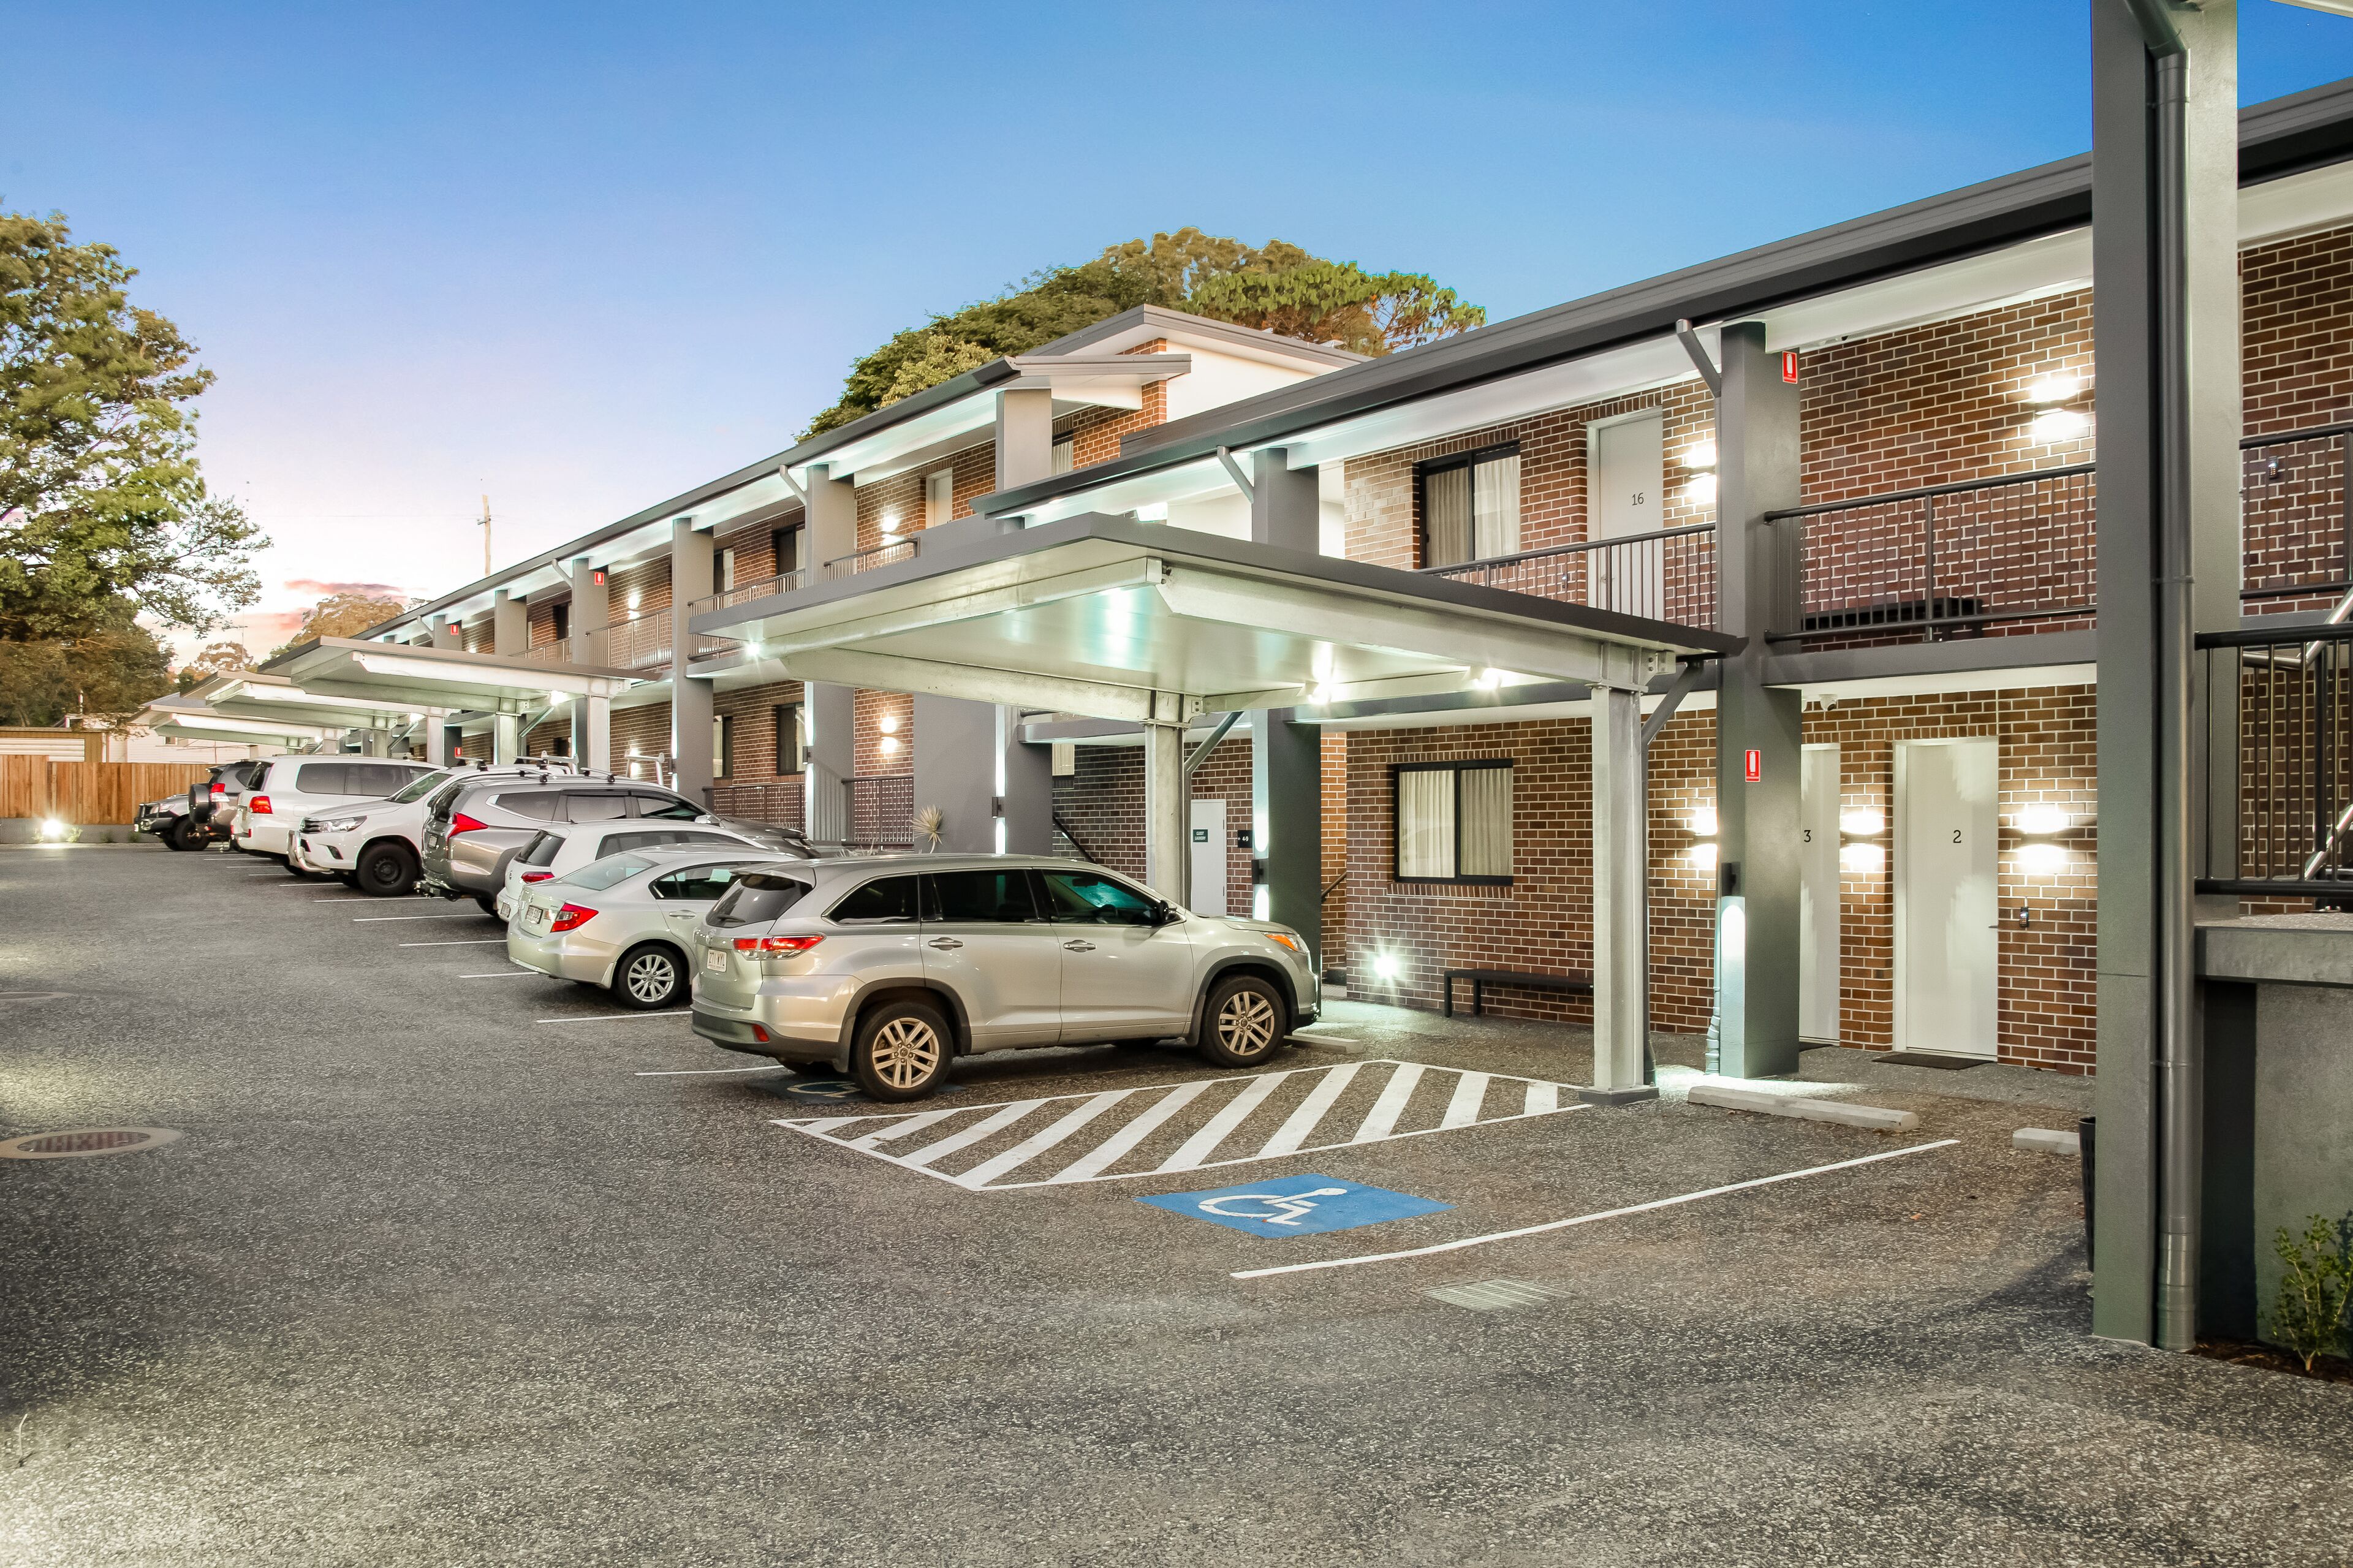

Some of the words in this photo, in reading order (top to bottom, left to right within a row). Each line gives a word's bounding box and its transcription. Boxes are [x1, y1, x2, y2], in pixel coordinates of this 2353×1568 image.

[1632, 492, 1644, 506] 16
[1803, 829, 1811, 843] 3
[1953, 830, 1961, 843] 2
